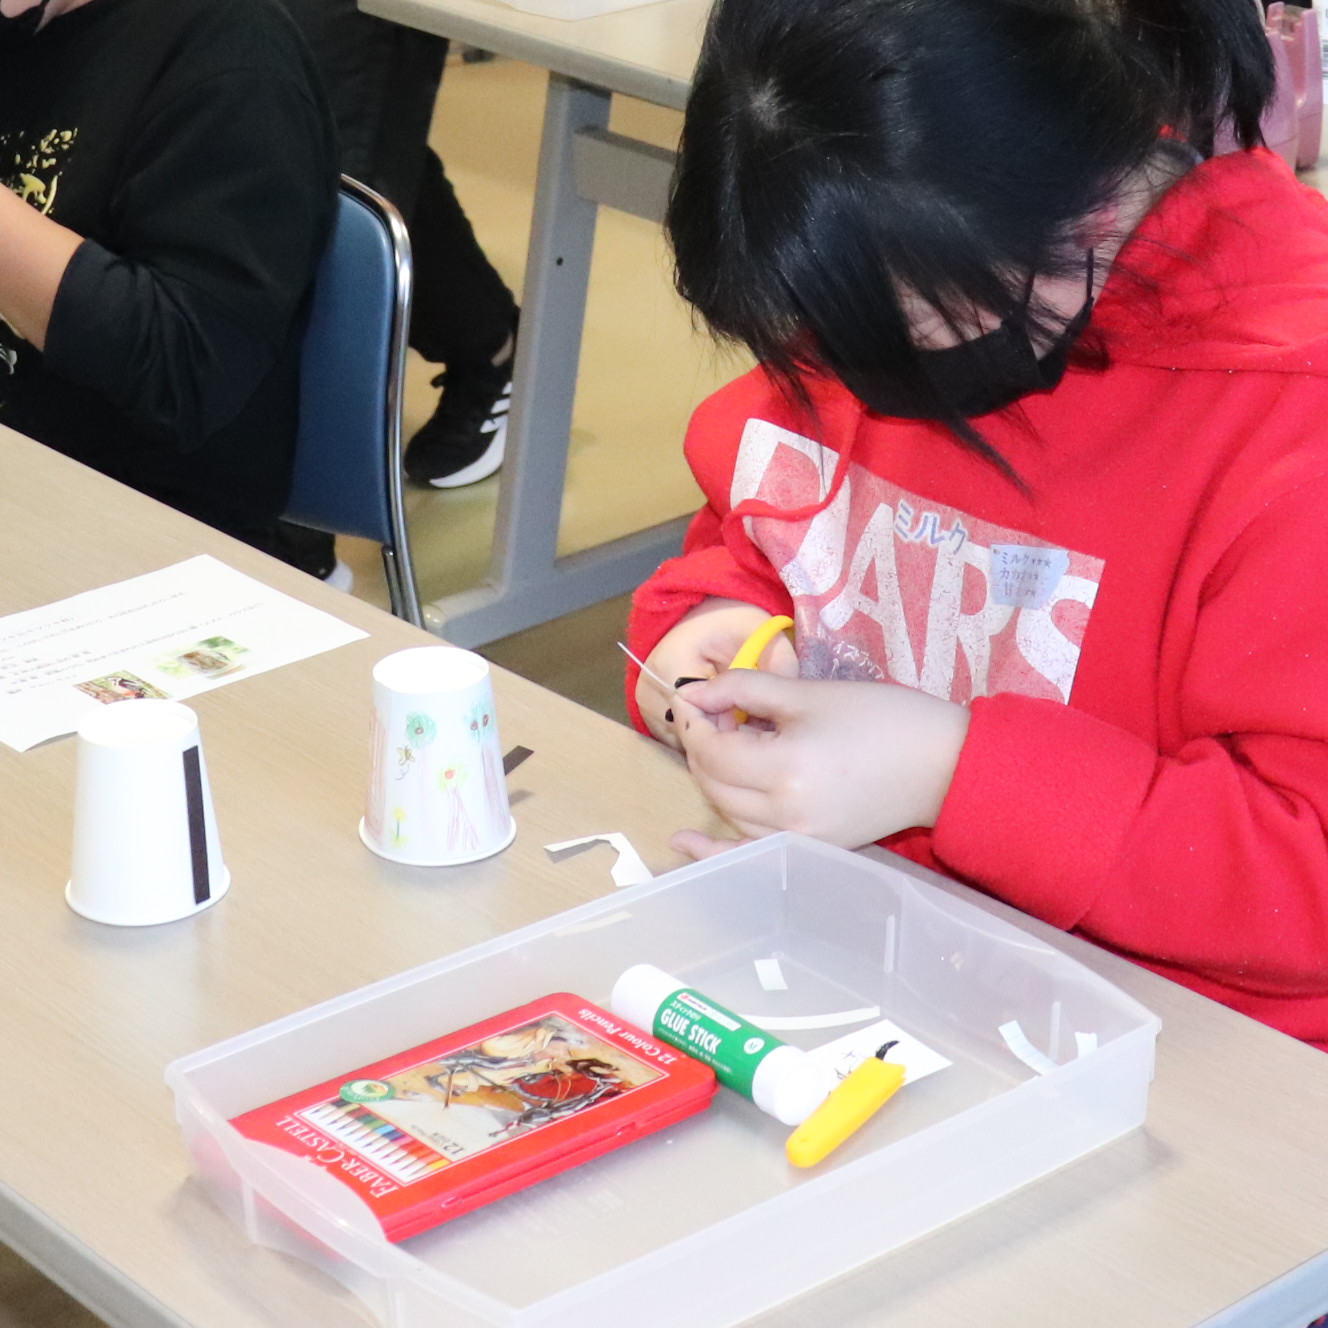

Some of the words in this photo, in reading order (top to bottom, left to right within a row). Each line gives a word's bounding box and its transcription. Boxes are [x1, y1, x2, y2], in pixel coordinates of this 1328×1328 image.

[894, 501, 967, 555] ミルク
[578, 1008, 622, 1035] Pencils
[660, 1008, 690, 1036] GLUE
[688, 1024, 722, 1055] STICK
[619, 1031, 661, 1057] Colour
[657, 1053, 677, 1065] 12
[275, 1115, 400, 1199] FABER-CASTELL
